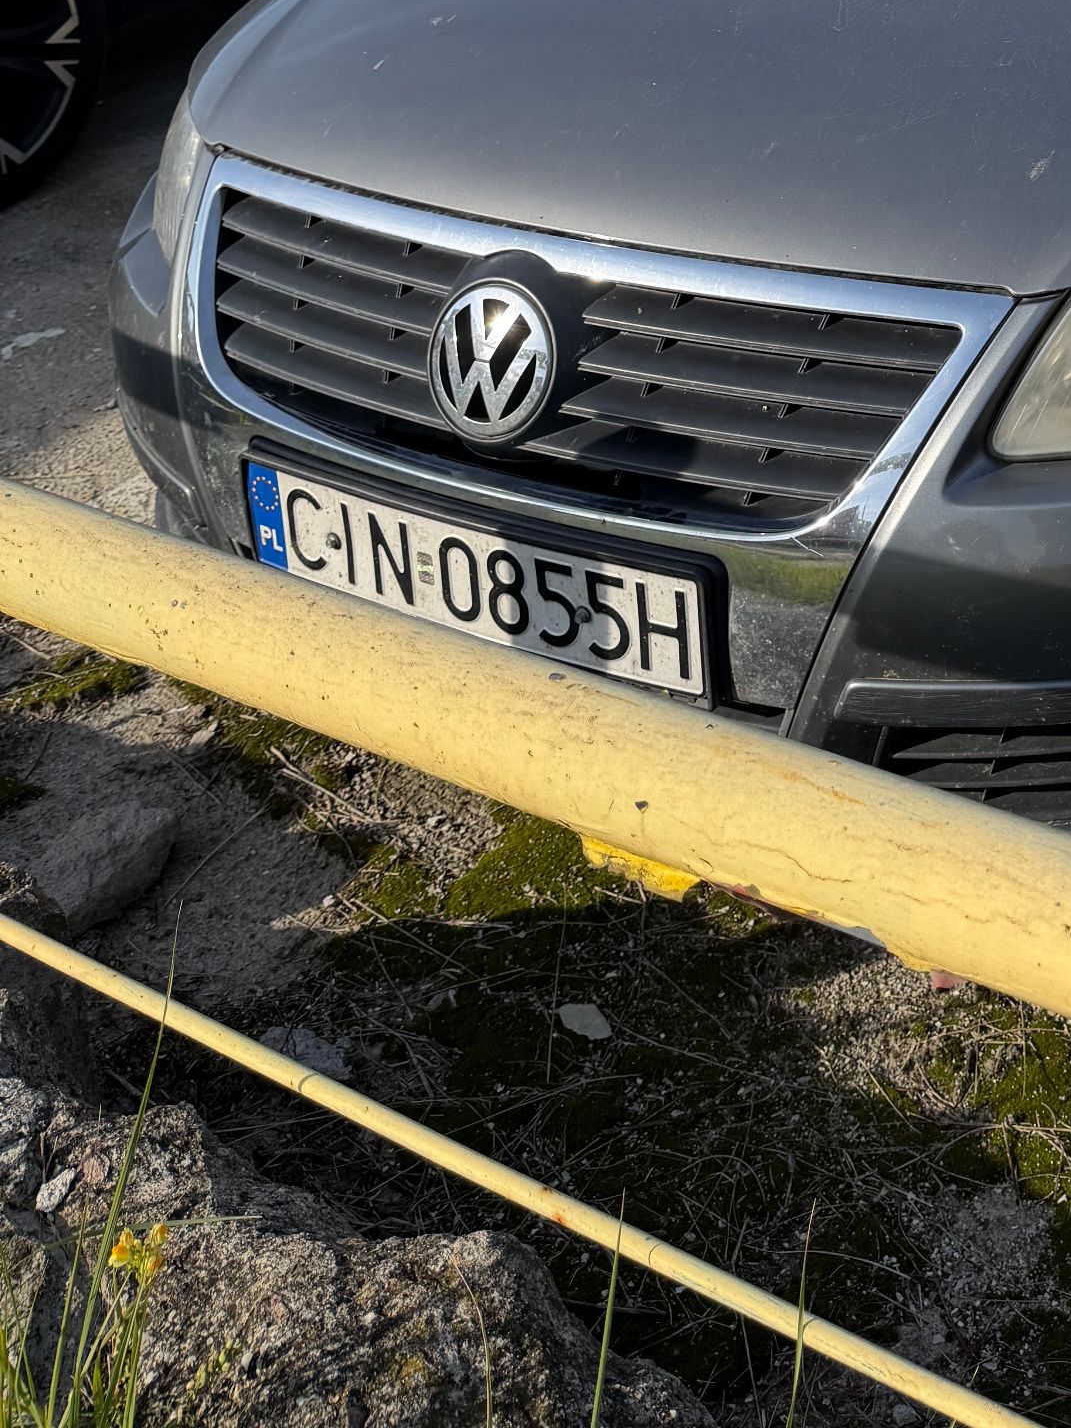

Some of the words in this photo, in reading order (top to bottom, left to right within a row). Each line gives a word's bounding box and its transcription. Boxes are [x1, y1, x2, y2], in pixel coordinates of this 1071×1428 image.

[259, 524, 284, 552] PL
[285, 488, 414, 606] CIN
[438, 535, 691, 680] 0855H
